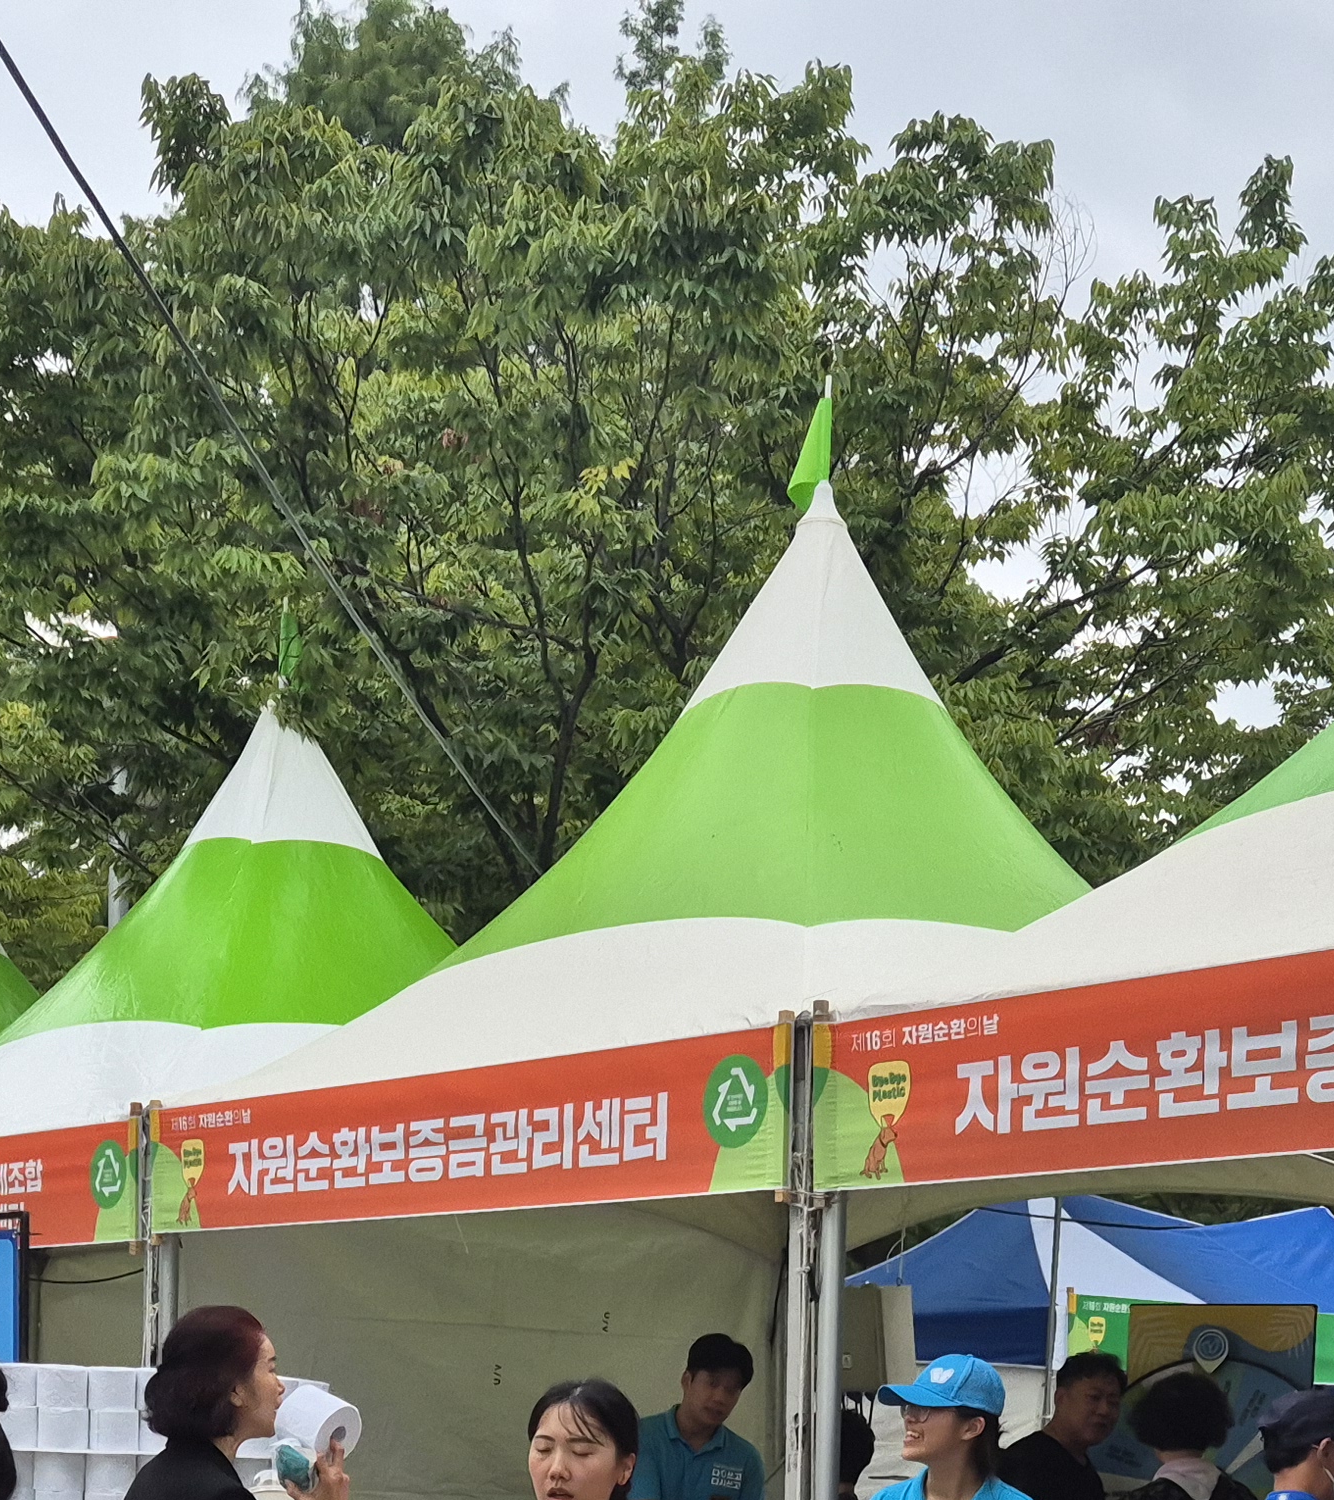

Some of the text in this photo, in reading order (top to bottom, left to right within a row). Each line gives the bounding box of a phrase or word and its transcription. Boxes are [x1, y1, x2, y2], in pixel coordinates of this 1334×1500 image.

[851, 1013, 1000, 1053] 제16회 자원순환의날
[872, 1085, 907, 1103] Plastic
[227, 1091, 669, 1197] 자원순환보증금관리센터
